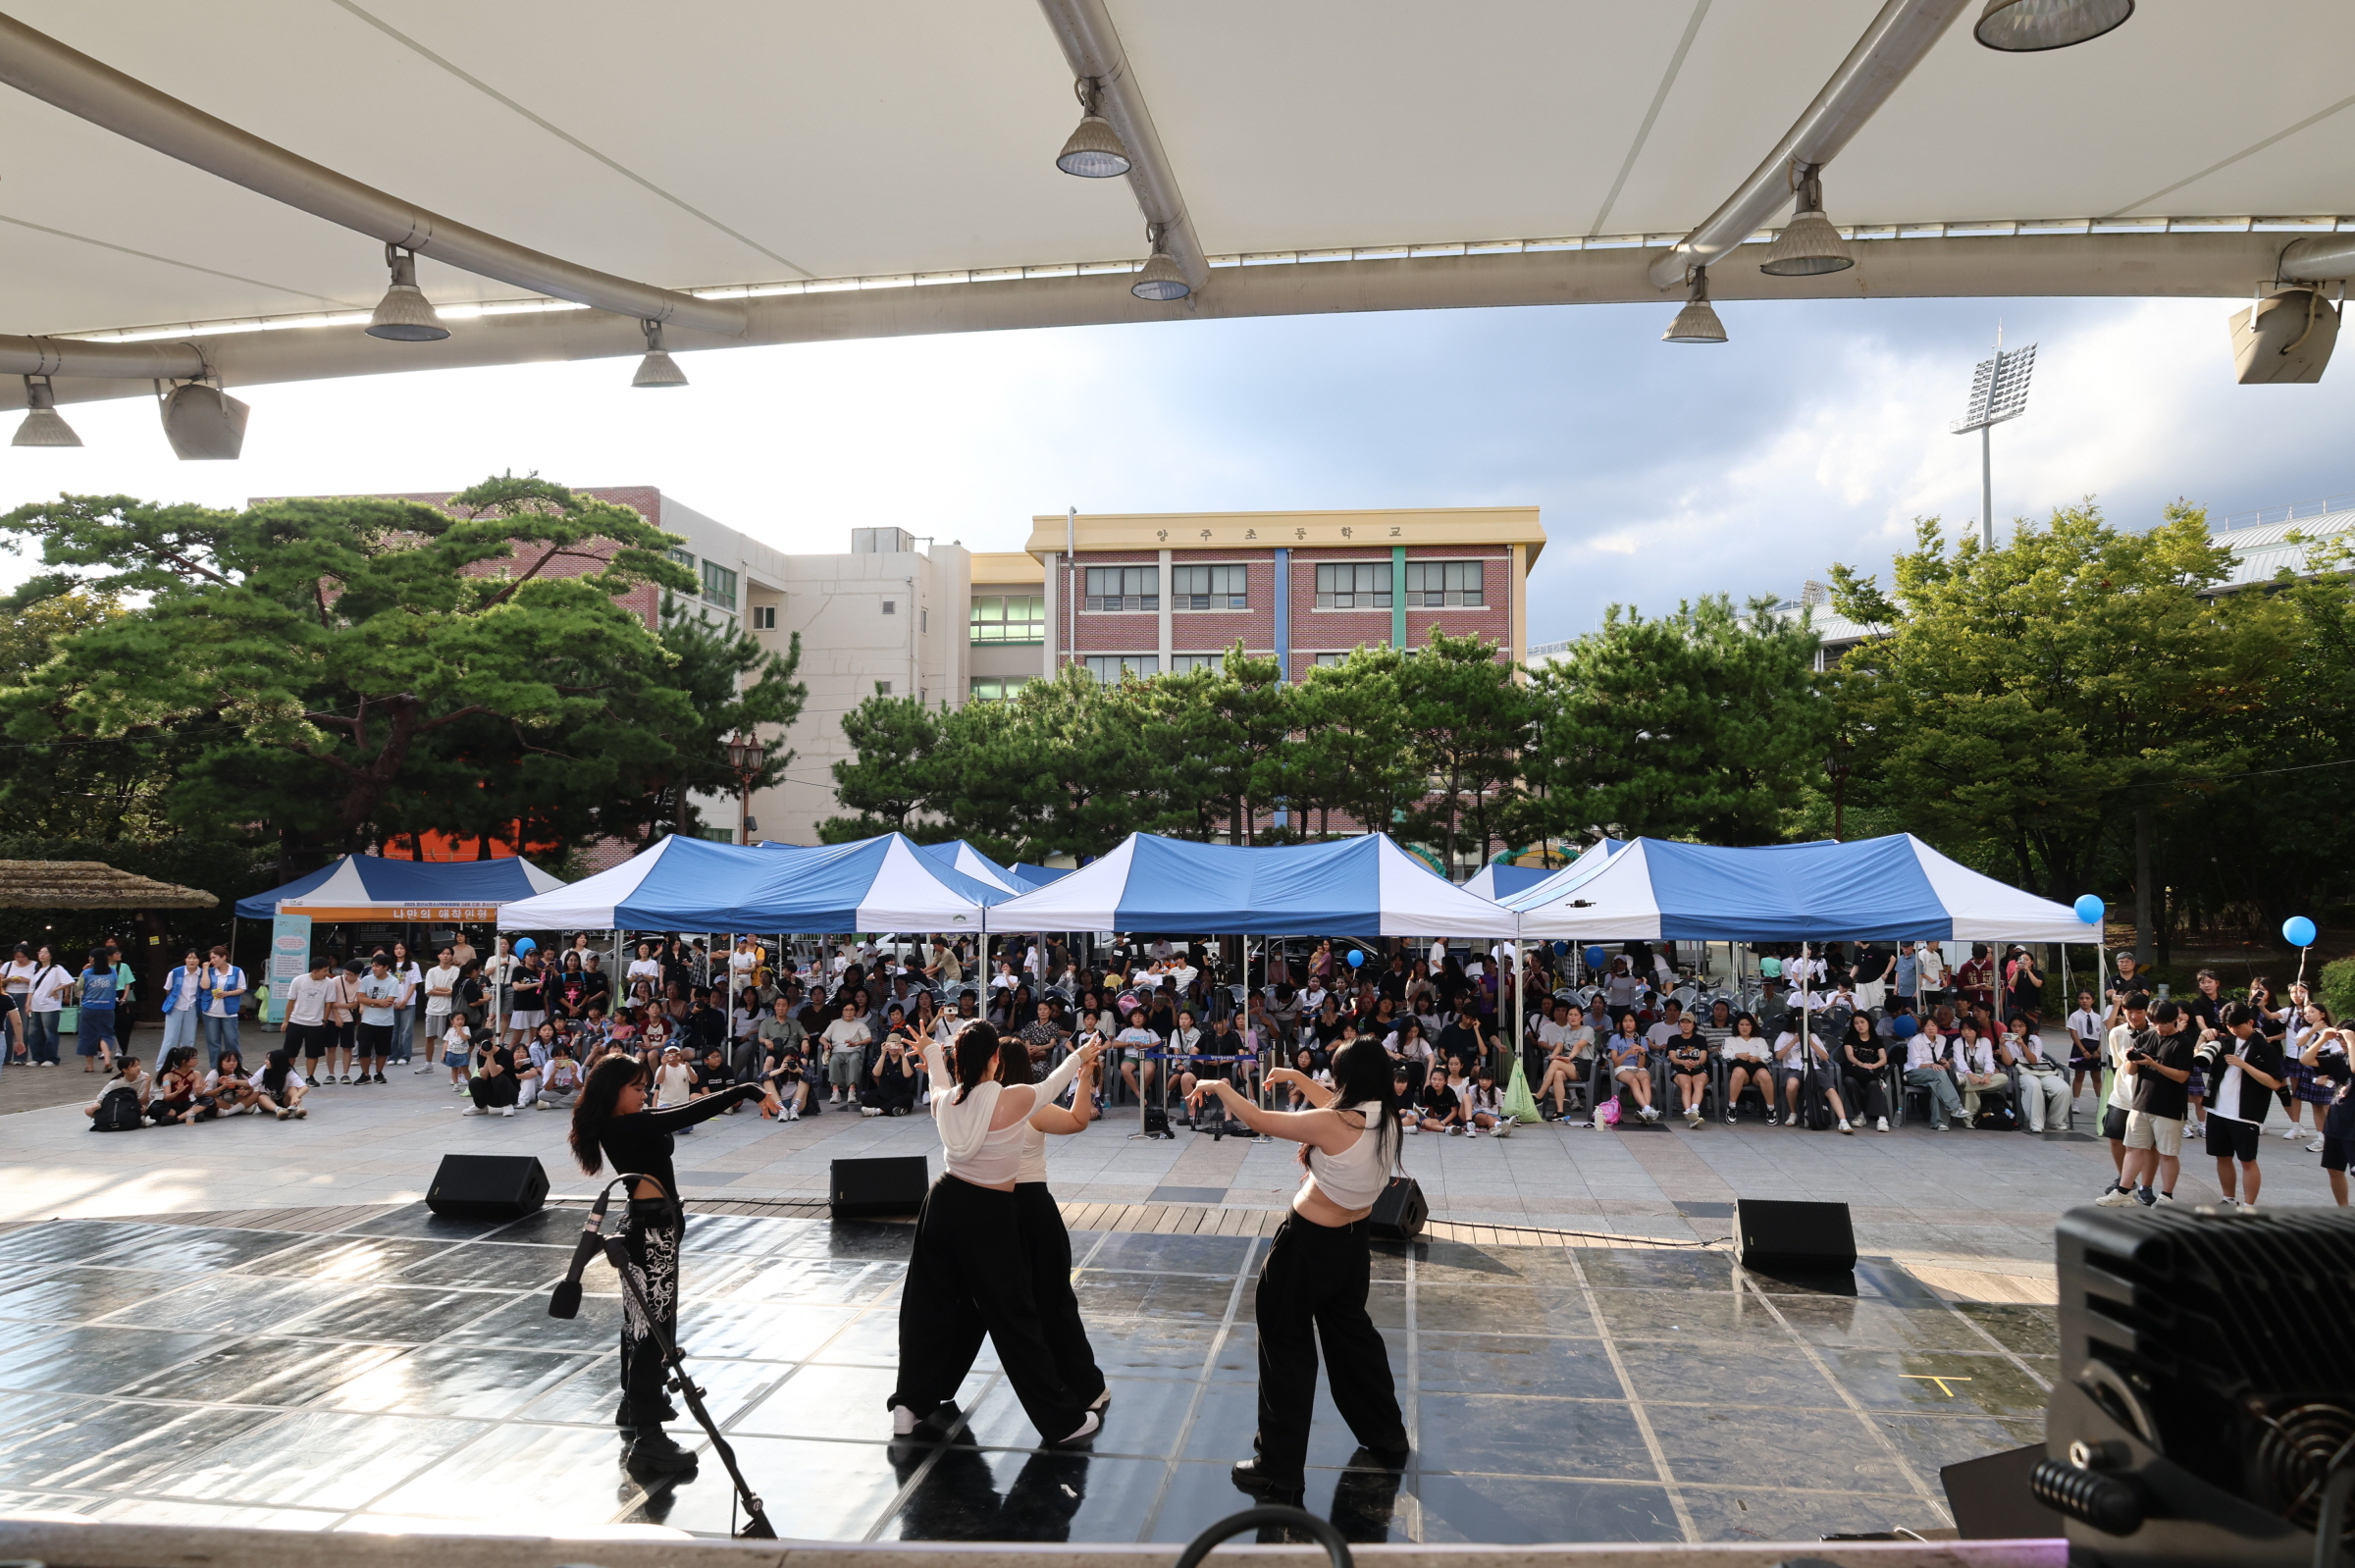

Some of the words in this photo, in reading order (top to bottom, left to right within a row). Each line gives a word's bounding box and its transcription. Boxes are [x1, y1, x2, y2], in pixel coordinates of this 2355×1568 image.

[1156, 526, 1402, 542] 양주초등학교
[393, 909, 431, 920] 나만의
[439, 909, 487, 920] 애착인형
